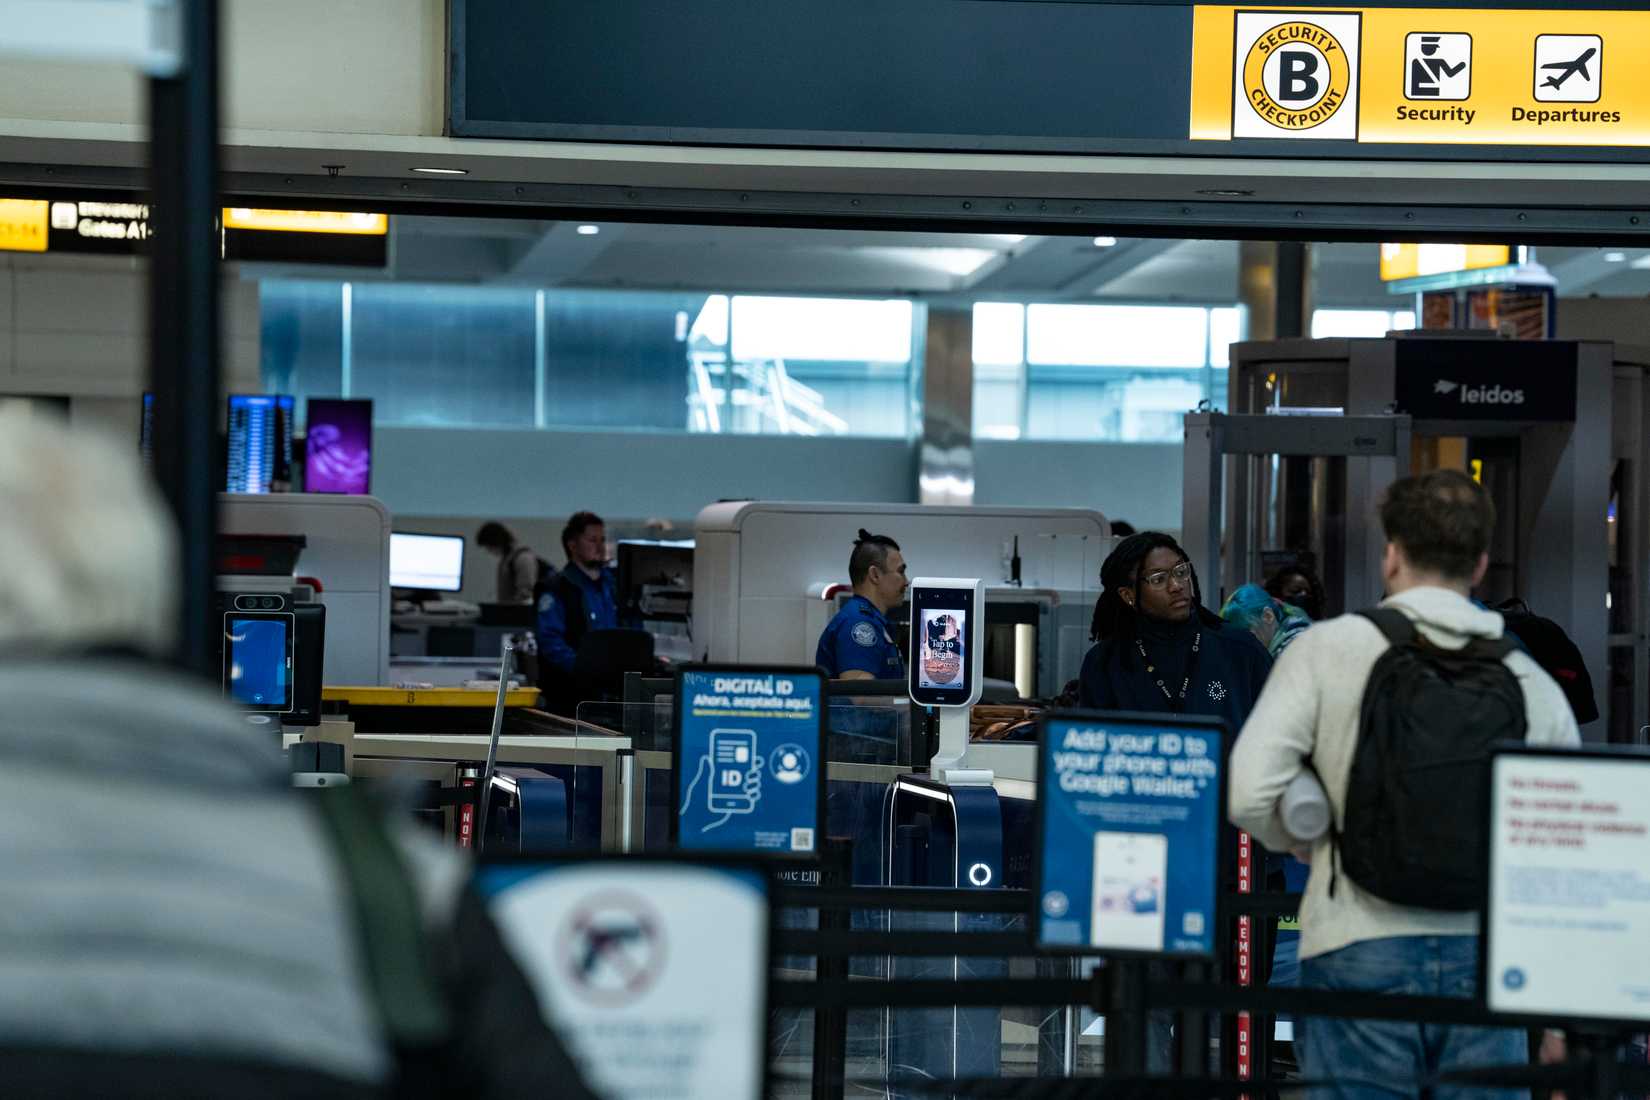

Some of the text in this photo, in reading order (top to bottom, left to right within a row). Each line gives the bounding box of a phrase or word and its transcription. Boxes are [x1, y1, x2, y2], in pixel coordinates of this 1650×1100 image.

[1258, 26, 1337, 54] SECURITY
[1279, 51, 1319, 101] B
[1251, 88, 1341, 126] CHECKPOINT
[1396, 105, 1476, 125] Security
[1511, 106, 1621, 125] Departures
[1461, 384, 1524, 404] leidos
[932, 640, 954, 651] Tap to
[932, 650, 953, 661] Begin
[714, 678, 773, 695] DIGITAL
[776, 680, 794, 695] ID
[693, 694, 730, 707] Ahora,
[1063, 728, 1208, 757] Add your ID to
[1053, 751, 1217, 779] your phone with
[721, 770, 742, 786] ID
[1059, 770, 1130, 797] Google
